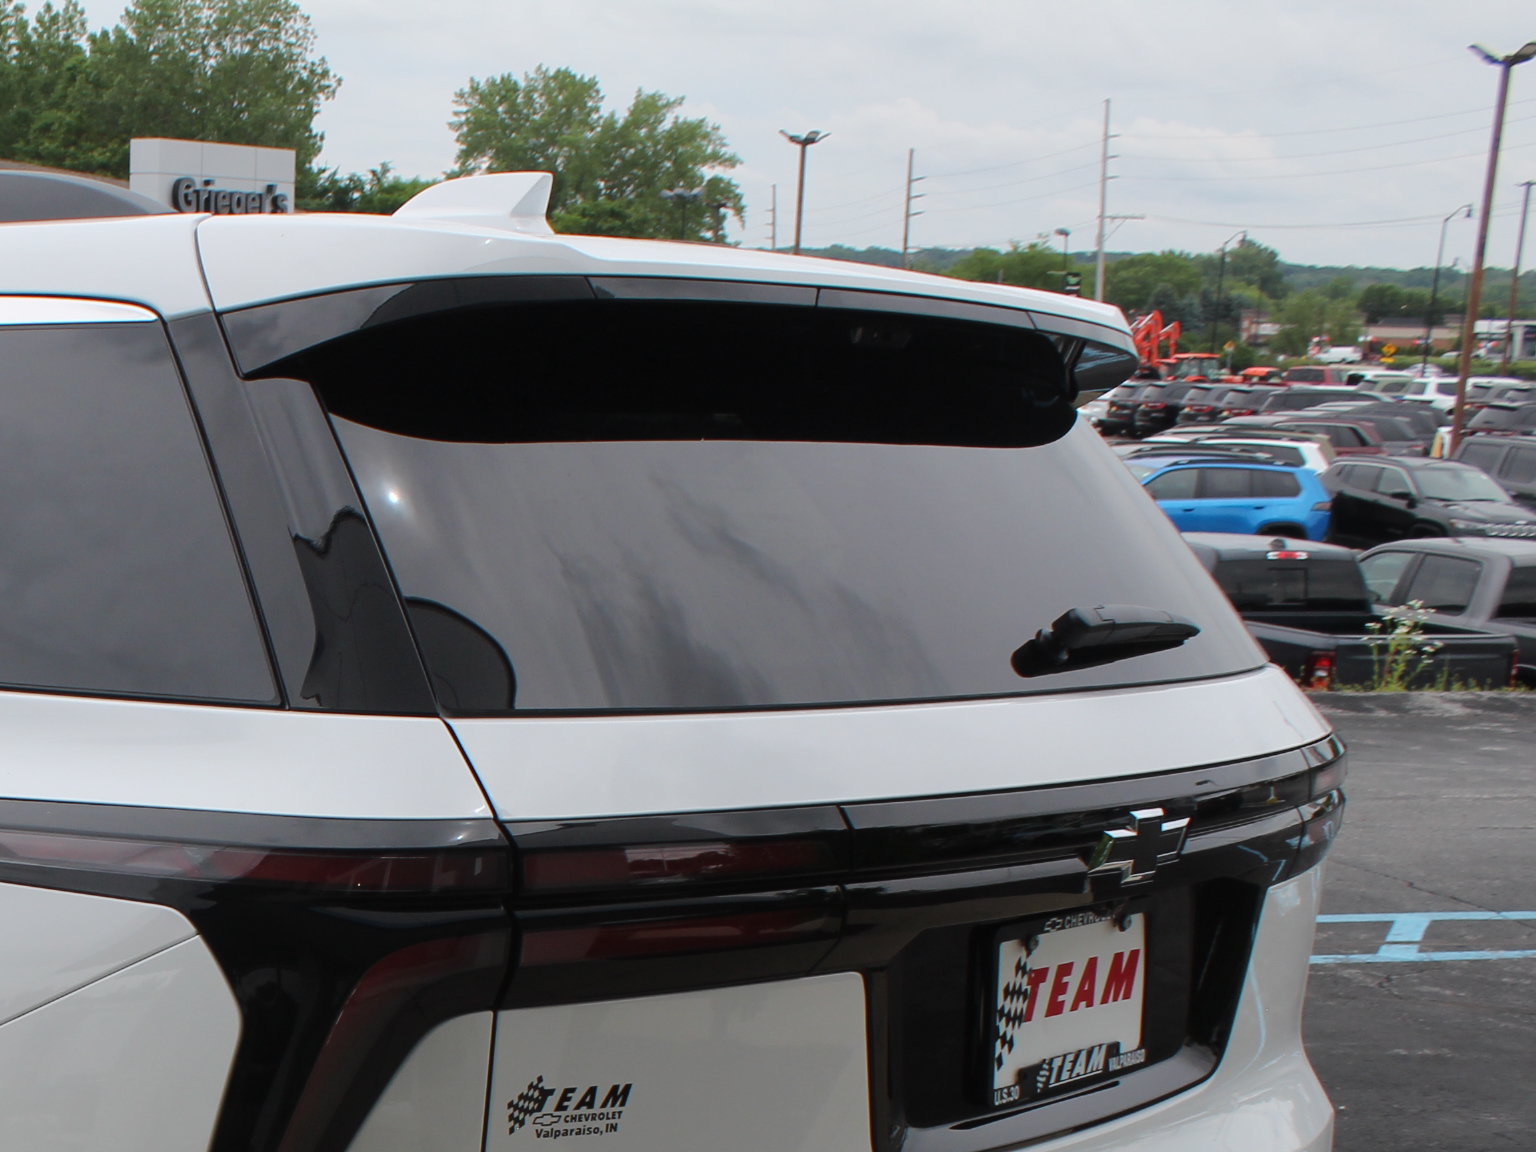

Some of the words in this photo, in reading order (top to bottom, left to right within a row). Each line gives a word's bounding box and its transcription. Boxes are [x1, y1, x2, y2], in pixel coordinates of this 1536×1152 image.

[1023, 949, 1141, 1023] TEAM
[1050, 1044, 1108, 1085] TEAM
[535, 1083, 633, 1113] TEAM
[535, 1125, 603, 1140] Valparaiso,
[605, 1123, 618, 1133] IN
[564, 1111, 623, 1123] CHEVROLET
